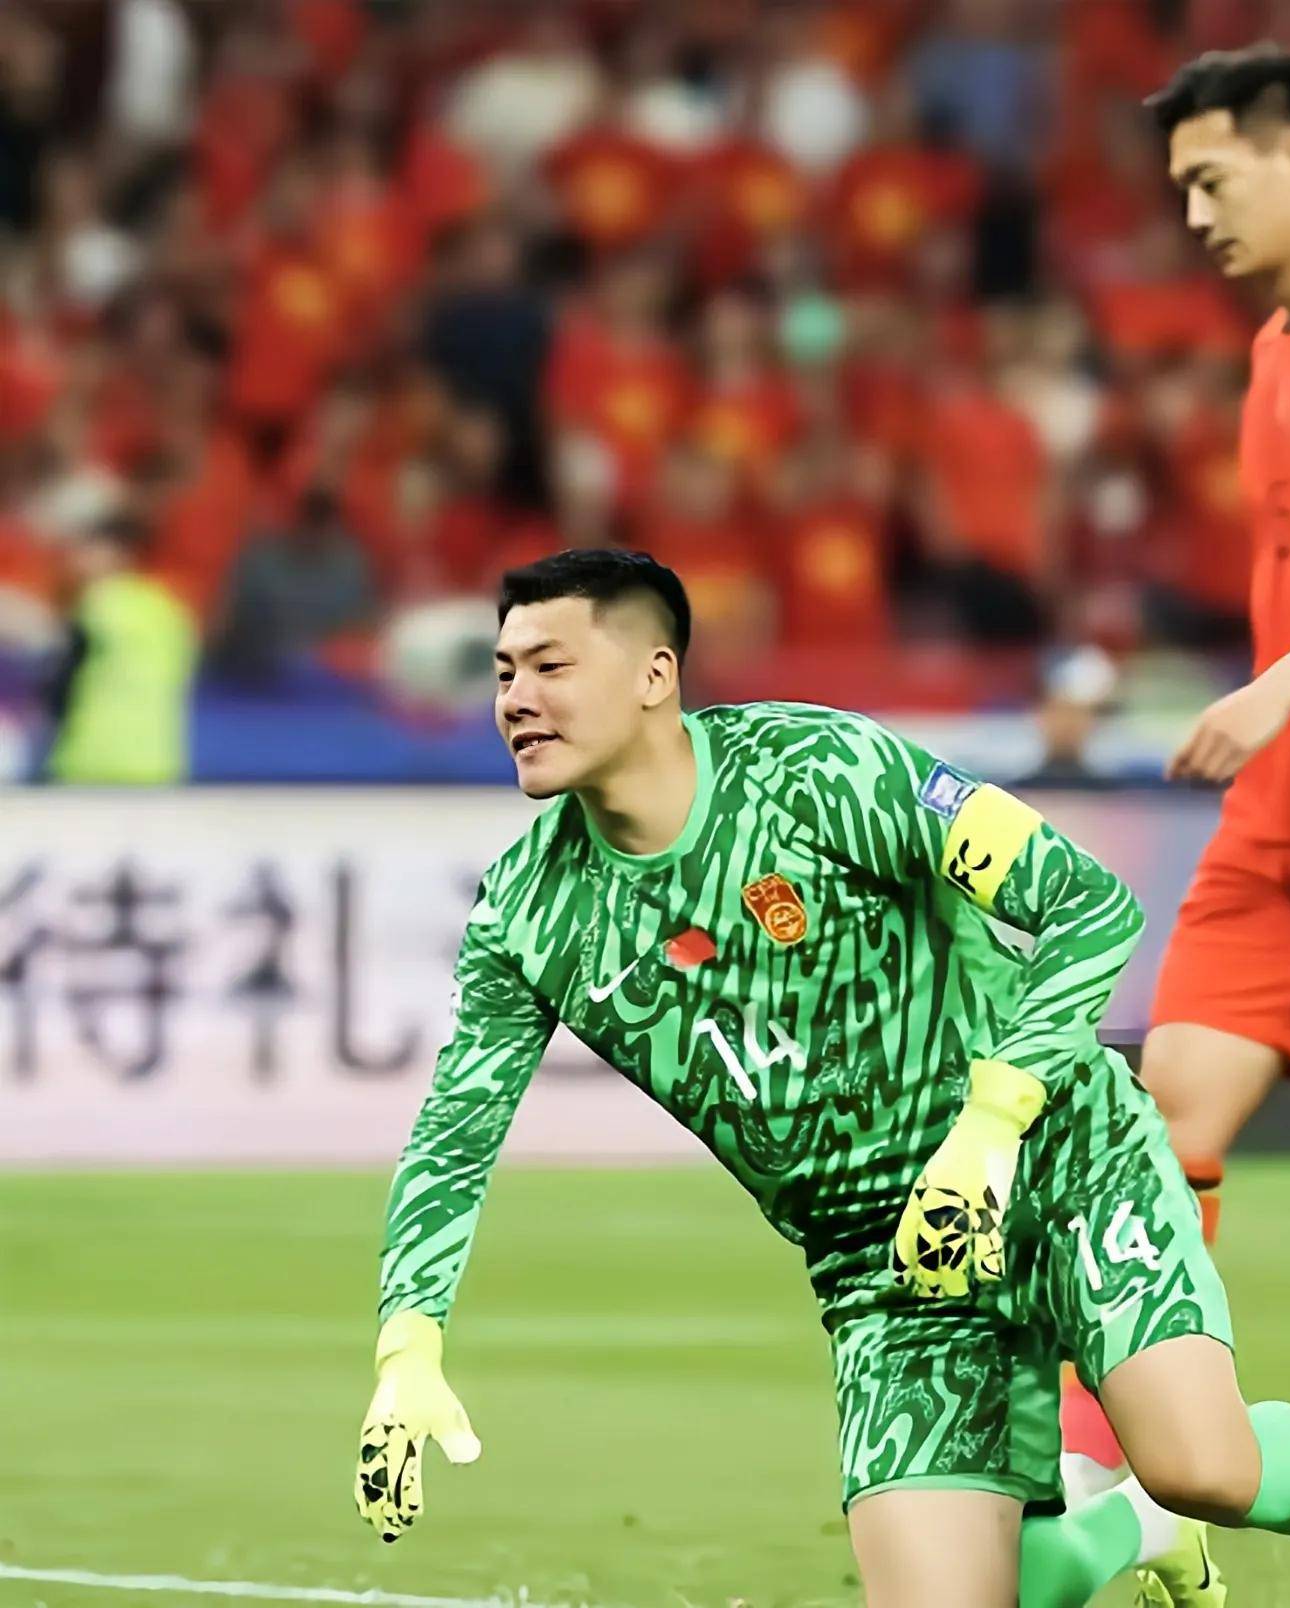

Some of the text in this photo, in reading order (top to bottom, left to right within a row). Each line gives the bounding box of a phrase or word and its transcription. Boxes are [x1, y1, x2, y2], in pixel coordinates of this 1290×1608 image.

[0, 854, 615, 1086] 待礼
[697, 1004, 807, 1100] 14
[1068, 1200, 1161, 1291] 14
